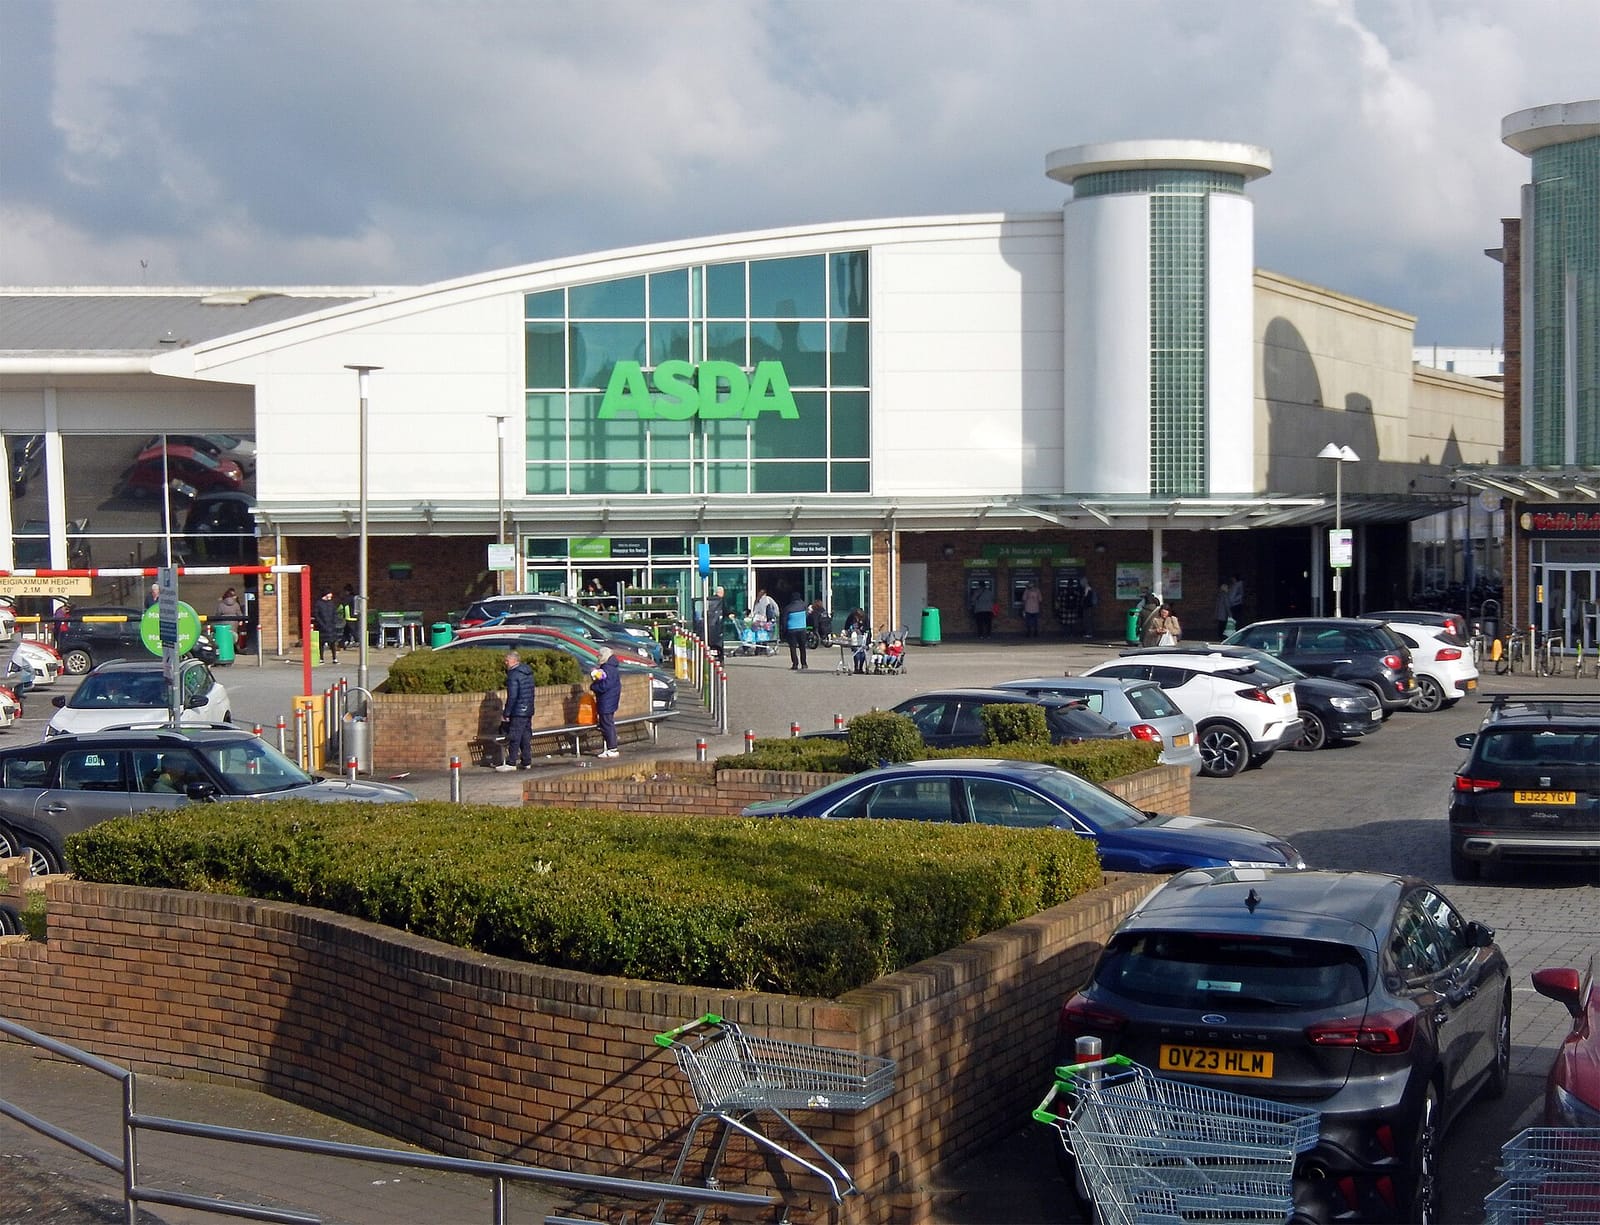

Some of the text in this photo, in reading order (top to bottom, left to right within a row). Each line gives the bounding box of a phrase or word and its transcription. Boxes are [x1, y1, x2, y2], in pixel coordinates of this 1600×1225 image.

[597, 360, 800, 420] ASDA
[1520, 792, 1571, 802] BJ22 YGV
[1168, 1048, 1264, 1073] OV23 HLM
